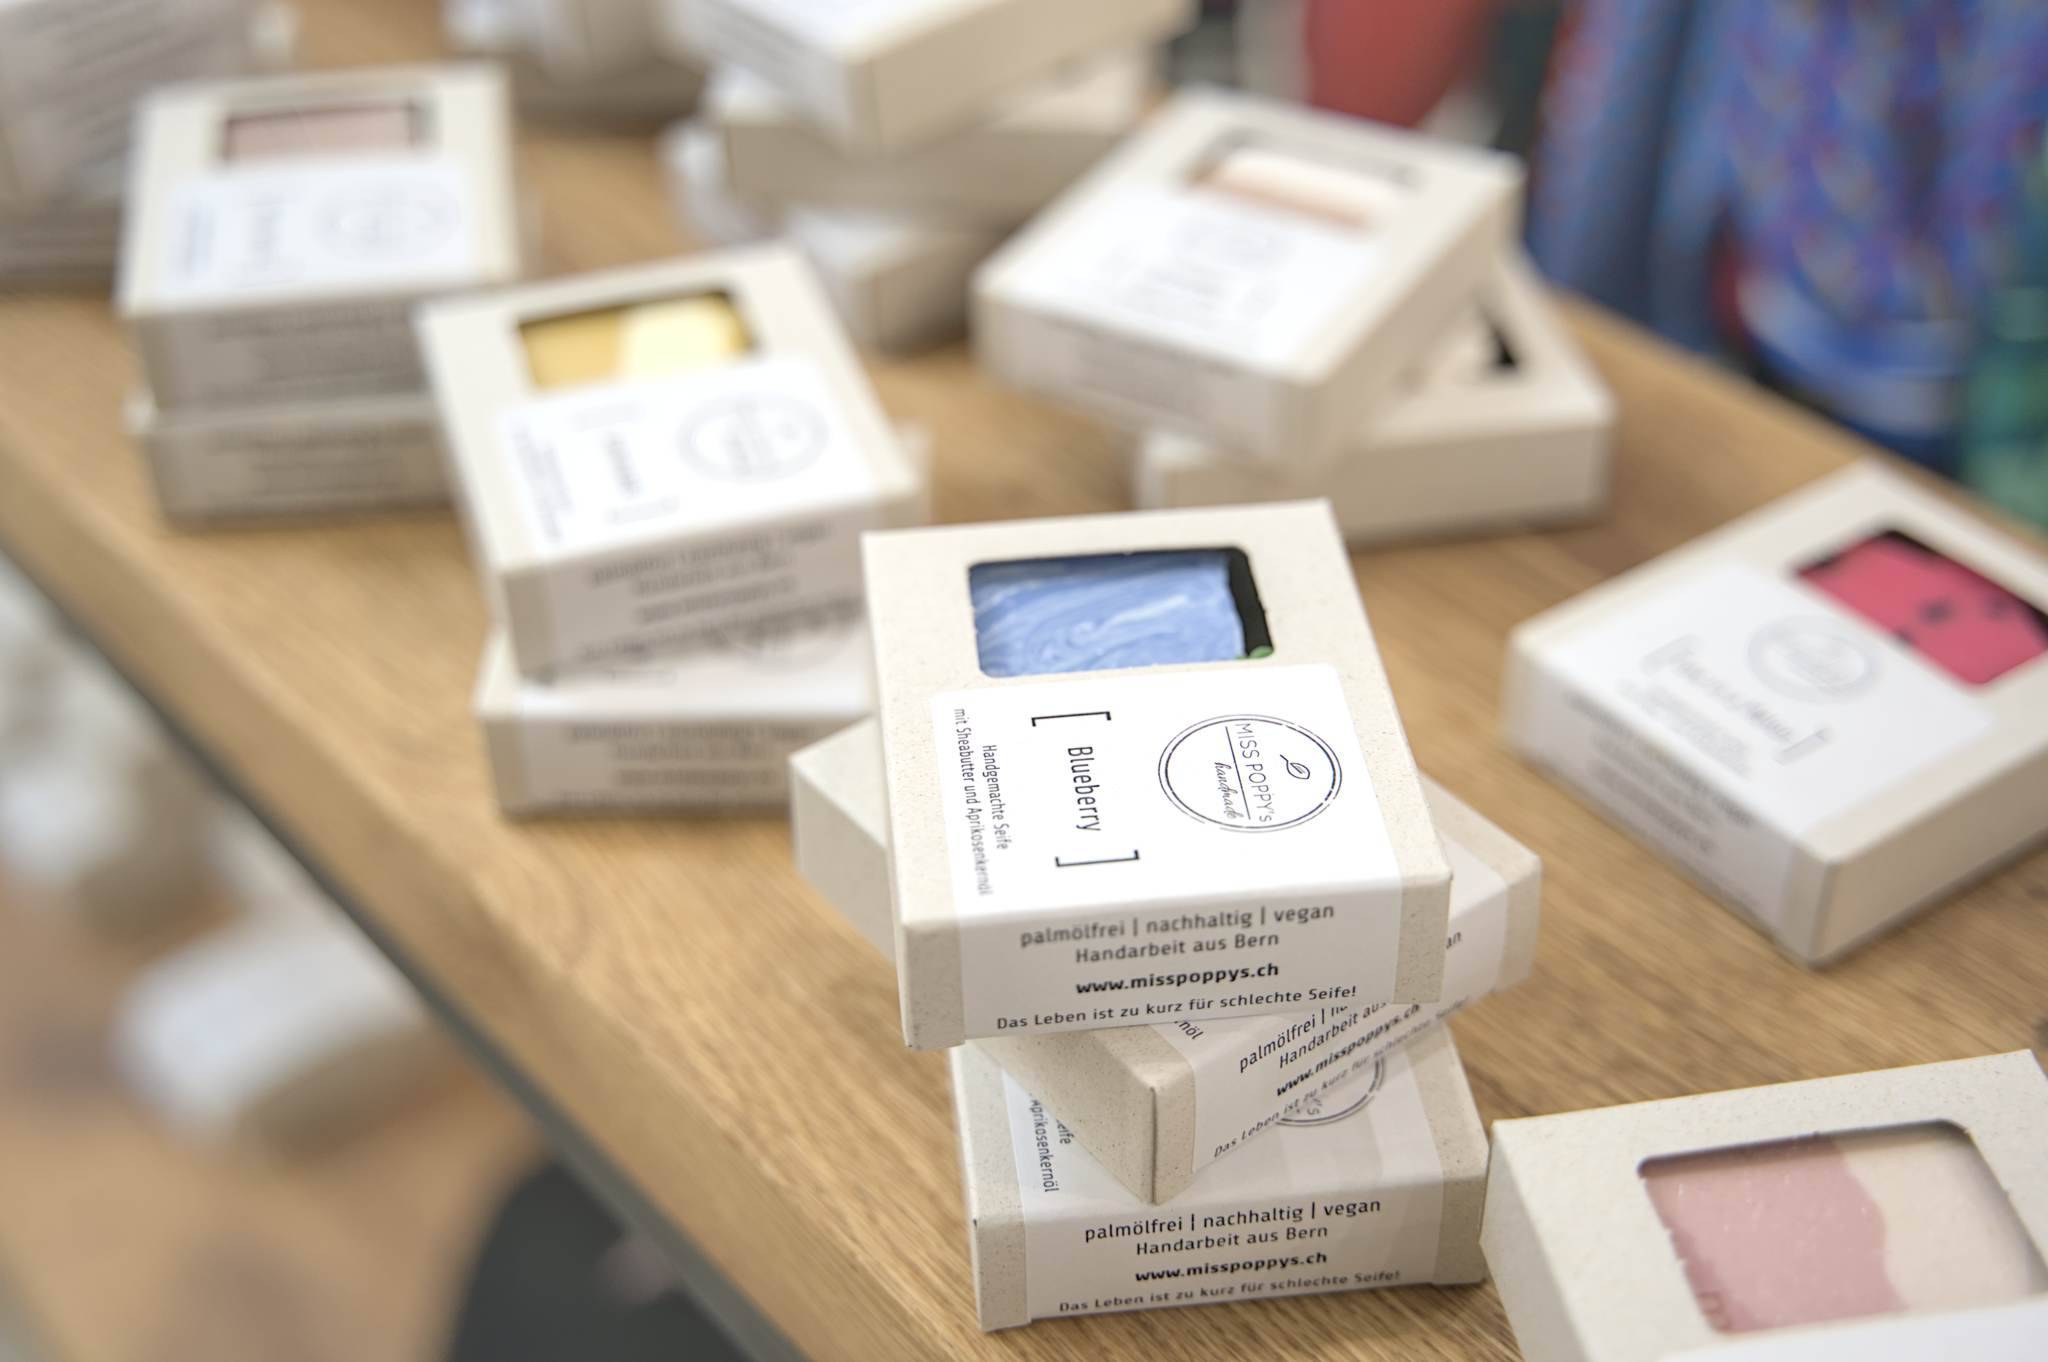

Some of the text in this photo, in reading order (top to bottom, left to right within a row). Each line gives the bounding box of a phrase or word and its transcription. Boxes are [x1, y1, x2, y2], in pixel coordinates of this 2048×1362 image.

[954, 708, 970, 725] mit
[956, 727, 975, 782] Sheabutter
[1235, 723, 1260, 760] MISS
[964, 785, 981, 804] und
[982, 744, 1012, 851] Handgemachte Seife
[1067, 746, 1101, 831] Blueberry
[1214, 761, 1244, 819] handmade
[1020, 919, 1125, 949] palmölfrei
[1146, 910, 1252, 934] nachhaltig
[1274, 905, 1335, 925] vegan
[1076, 933, 1279, 964] Handarbeit aus Bern
[1076, 963, 1279, 994] www.misspoppys.ch
[997, 985, 1356, 1030] Das Leben ist zu kurz für schlechte Seife!
[1239, 1014, 1315, 1074] palmölfrei
[1277, 1004, 1419, 1096] www.misspoppys.ch
[1279, 1013, 1358, 1069] Handarbeit
[1213, 1138, 1237, 1158] Das
[1241, 1112, 1280, 1141] Leben
[1085, 1216, 1183, 1243] palmölfrei
[1203, 1206, 1303, 1228] nachhaltig
[1324, 1200, 1381, 1218] vegan
[1136, 1226, 1328, 1256] Handarbeit aus Bern
[1135, 1252, 1327, 1282] www.misspoppys.ch
[1059, 1270, 1401, 1313] Das Leben ist zu kurz für schlechte Seife!
